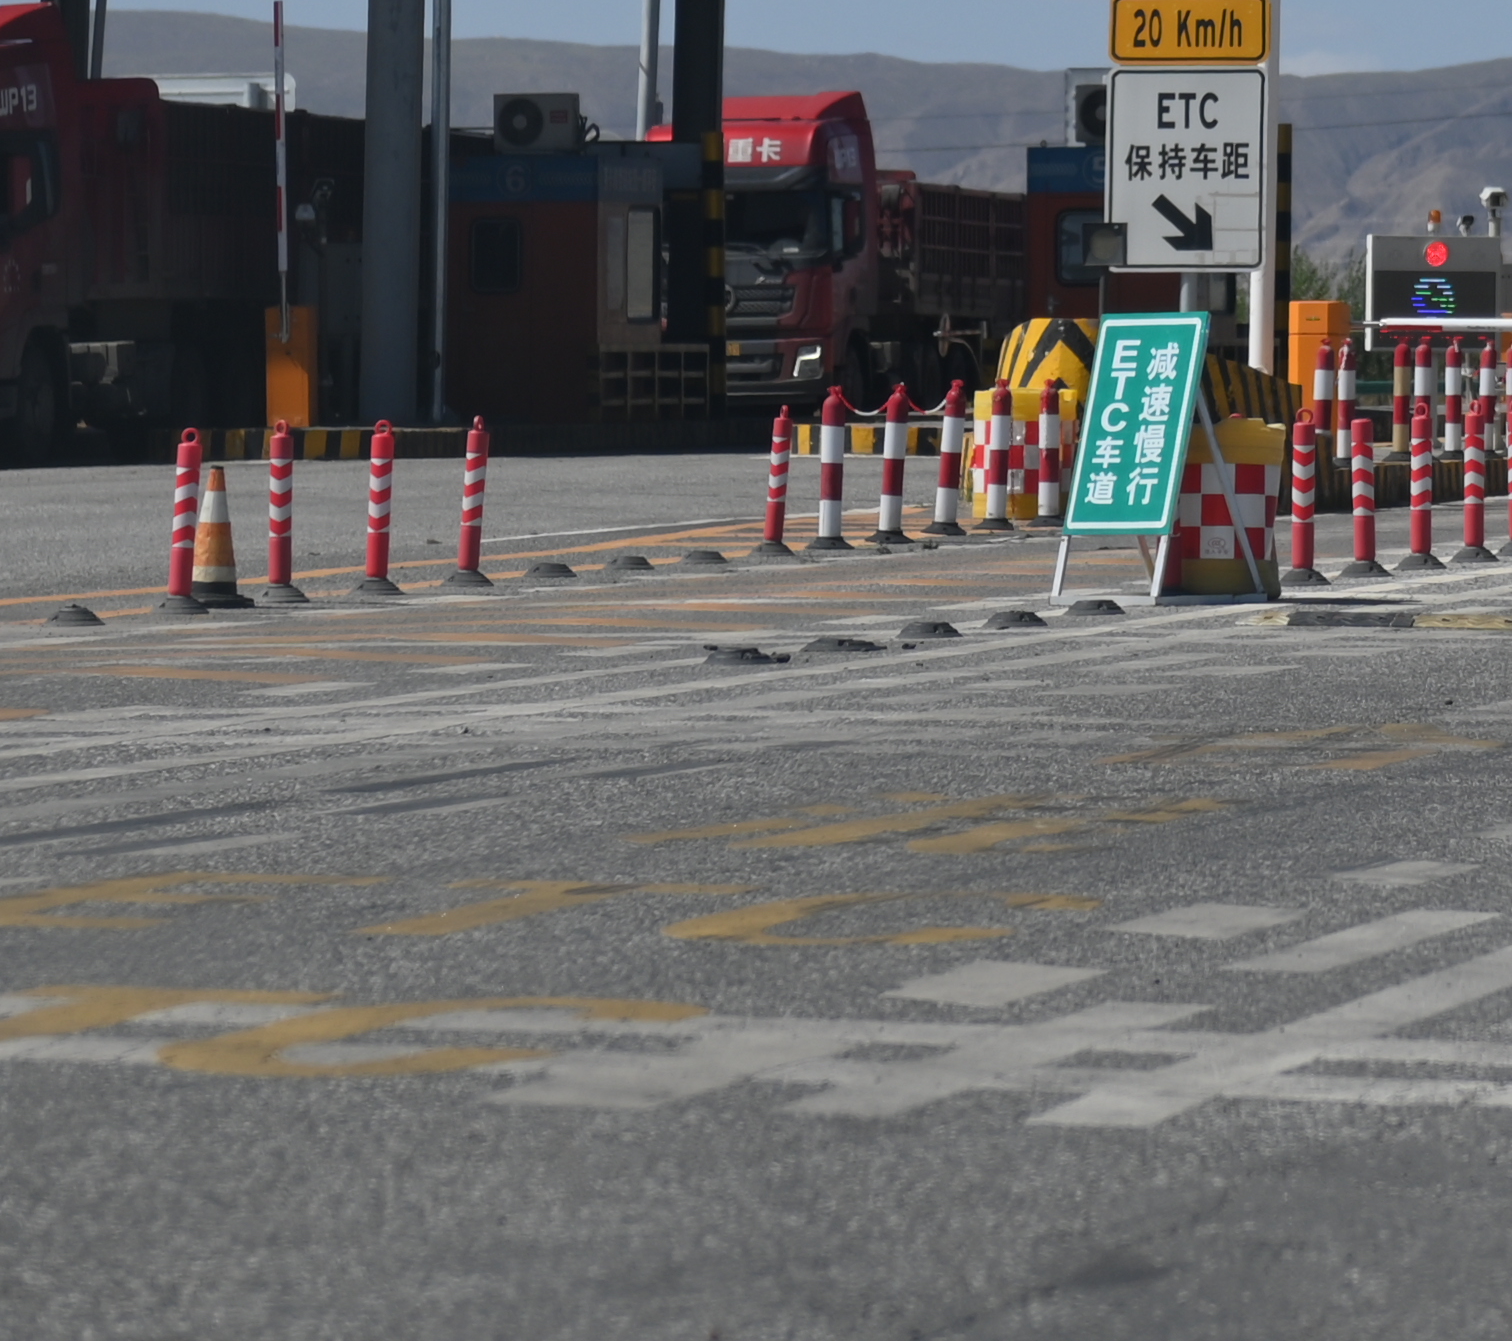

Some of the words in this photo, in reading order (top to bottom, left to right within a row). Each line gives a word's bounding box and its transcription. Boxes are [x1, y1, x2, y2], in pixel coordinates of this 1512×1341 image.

[1133, 9, 1163, 48] 20
[1176, 7, 1243, 49] Km/h
[1156, 92, 1219, 130] ETC
[728, 137, 782, 164] 重卡
[1124, 143, 1250, 180] 保持车距
[505, 164, 525, 192] 6
[1084, 339, 1141, 505] ETC车道
[1126, 342, 1180, 506] 减速慢行
